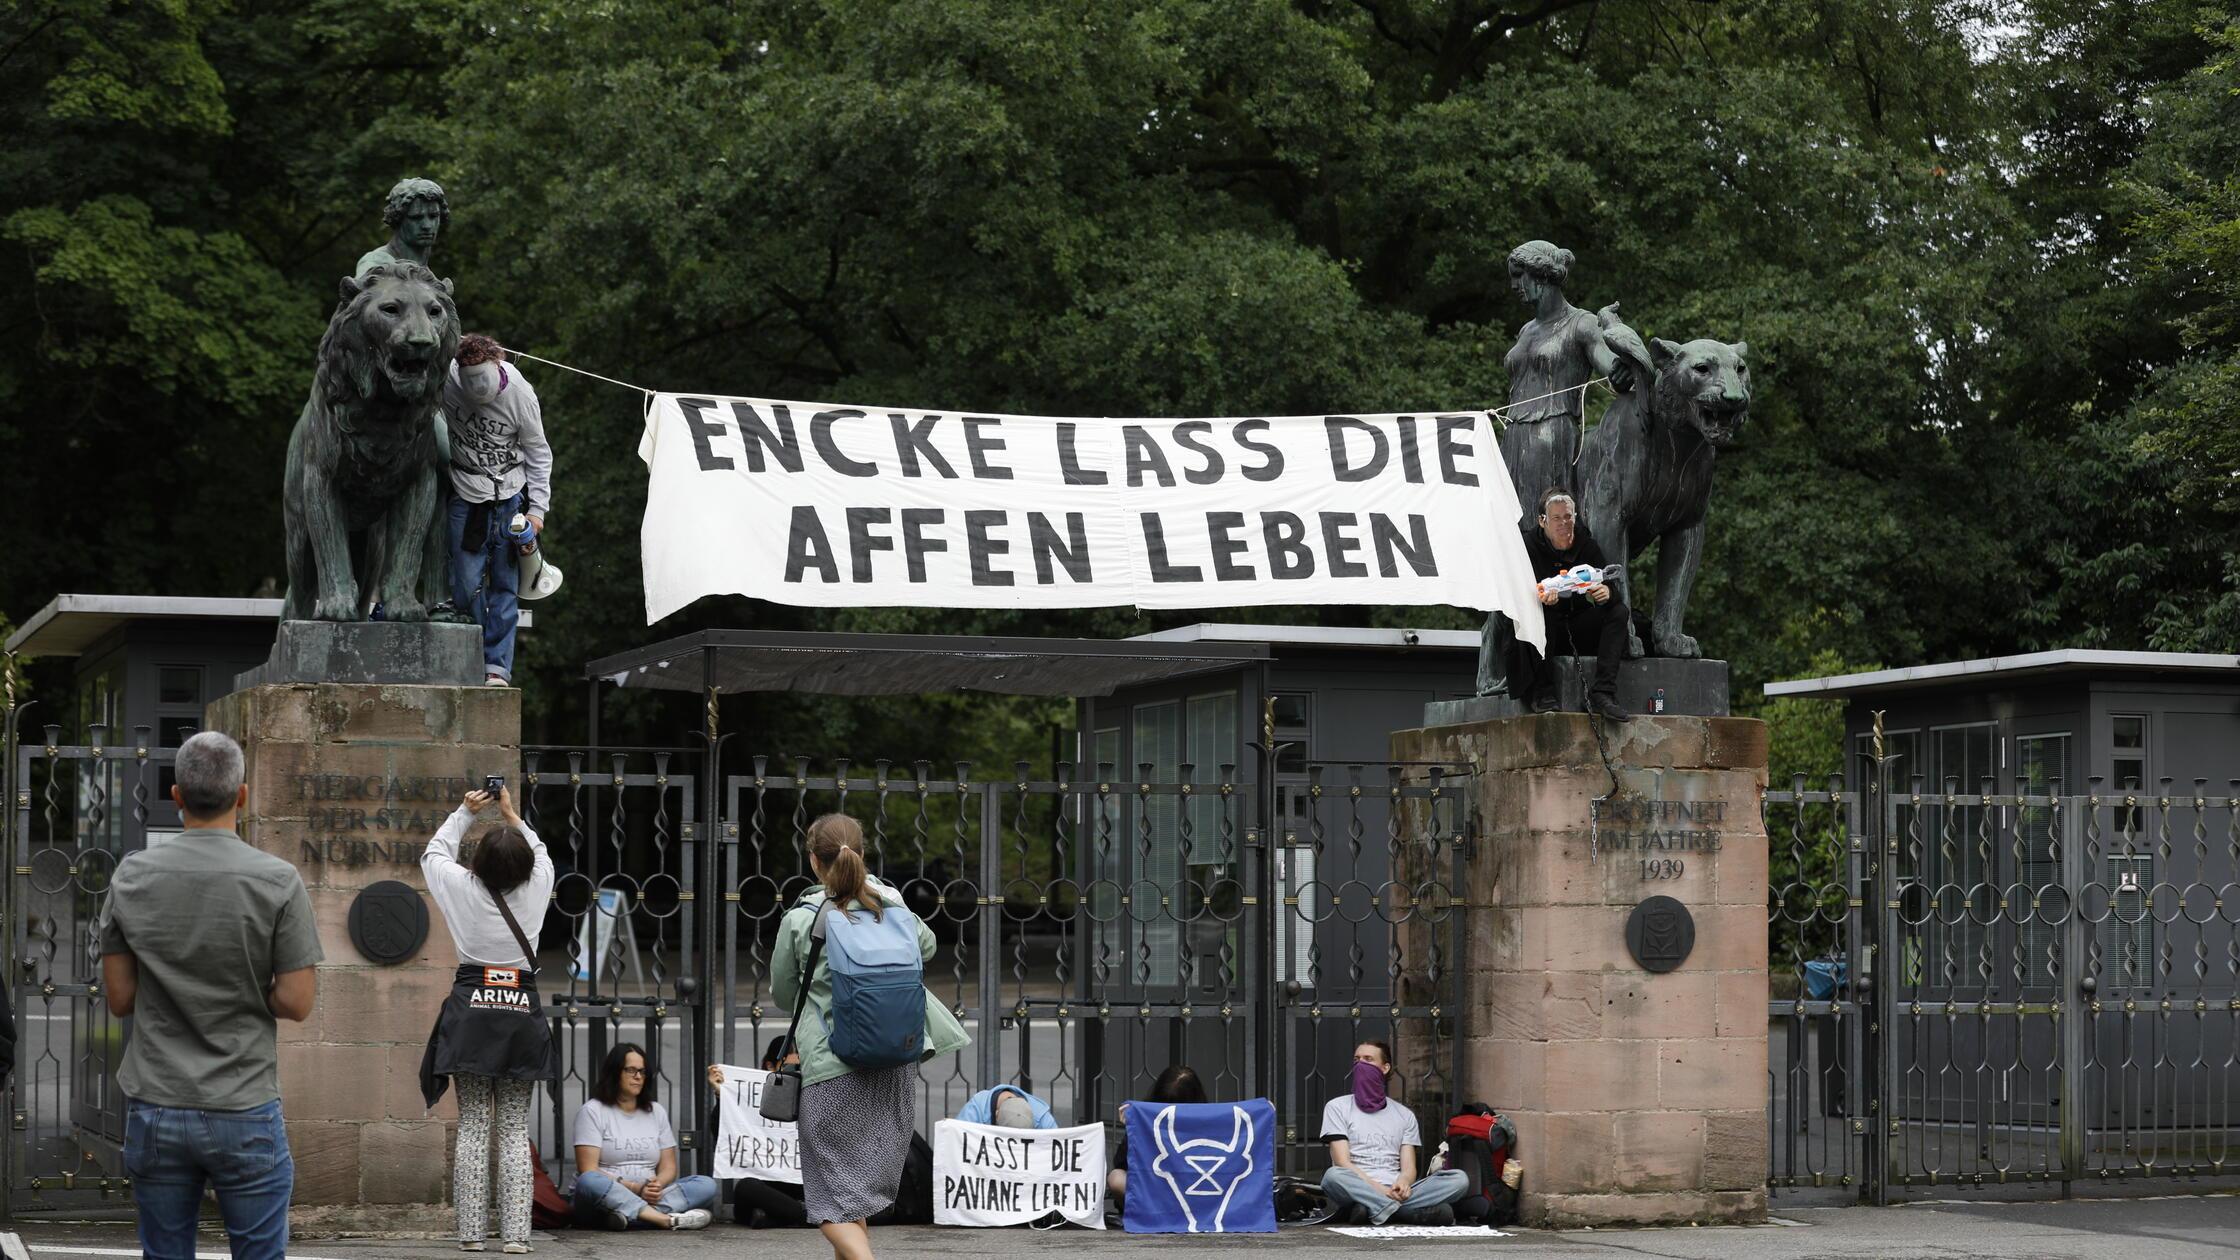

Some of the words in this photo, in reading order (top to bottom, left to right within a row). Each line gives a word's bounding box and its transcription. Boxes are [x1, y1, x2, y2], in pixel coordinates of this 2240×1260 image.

[455, 406, 508, 435] LASST
[676, 397, 1014, 480] ENCKE
[1056, 419, 1285, 487] LASS
[1324, 417, 1480, 487] DIE
[784, 505, 1093, 586] AFFEN
[1140, 510, 1439, 583] LEBEN
[308, 808, 368, 831] DER
[377, 808, 450, 832] STAD
[1600, 829, 1632, 850] IM
[1639, 829, 1723, 850] JAHRE
[1640, 859, 1684, 880] 1939
[470, 988, 530, 1007] ARIWA
[734, 1079, 766, 1108] TIE
[614, 1136, 655, 1150] LASST
[962, 1132, 1035, 1170] LASST
[1051, 1138, 1084, 1172] DIE
[945, 1175, 1024, 1212] PAVIANE
[1032, 1182, 1097, 1212] LEBEN!
